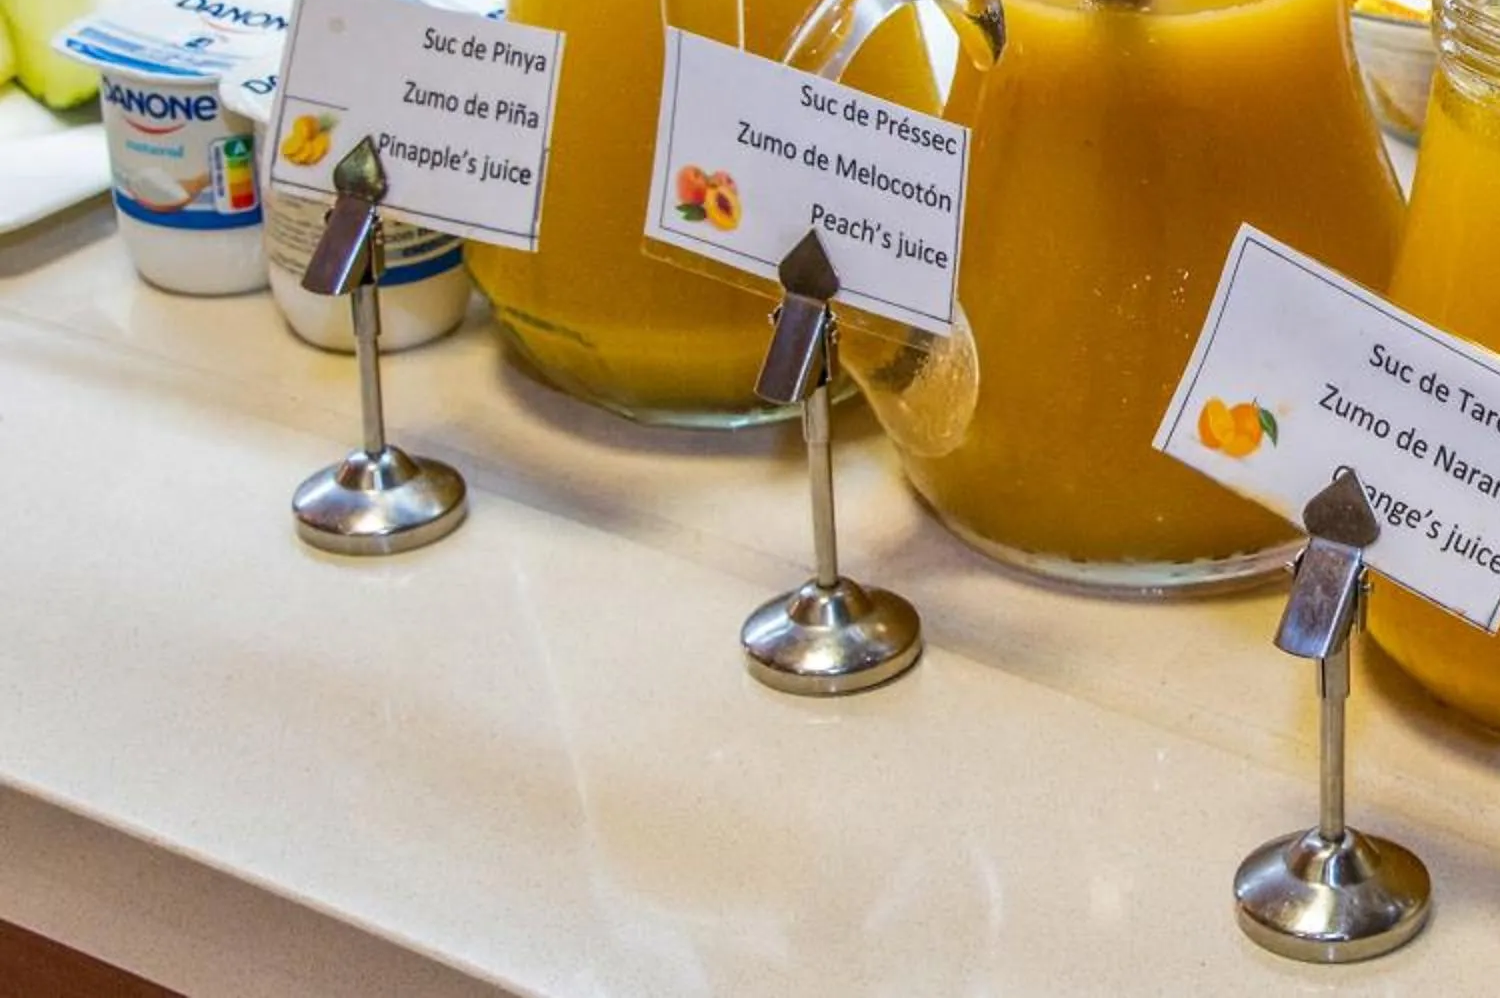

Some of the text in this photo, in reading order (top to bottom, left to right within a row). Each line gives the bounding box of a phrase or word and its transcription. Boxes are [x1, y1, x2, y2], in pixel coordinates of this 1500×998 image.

[423, 27, 547, 74] Suc de Pinya
[403, 81, 540, 129] Zumo de Piña
[800, 84, 958, 155] Suc de Préssec
[377, 133, 532, 186] Pinapple's juice
[737, 121, 952, 213] Zumo de Melocotón
[811, 204, 948, 269] Peach's juice
[1369, 343, 1414, 384] Suc
[1419, 372, 1450, 403] de
[1319, 382, 1391, 438] Zumo
[1396, 427, 1428, 459] de
[1332, 465, 1443, 540] ange's
